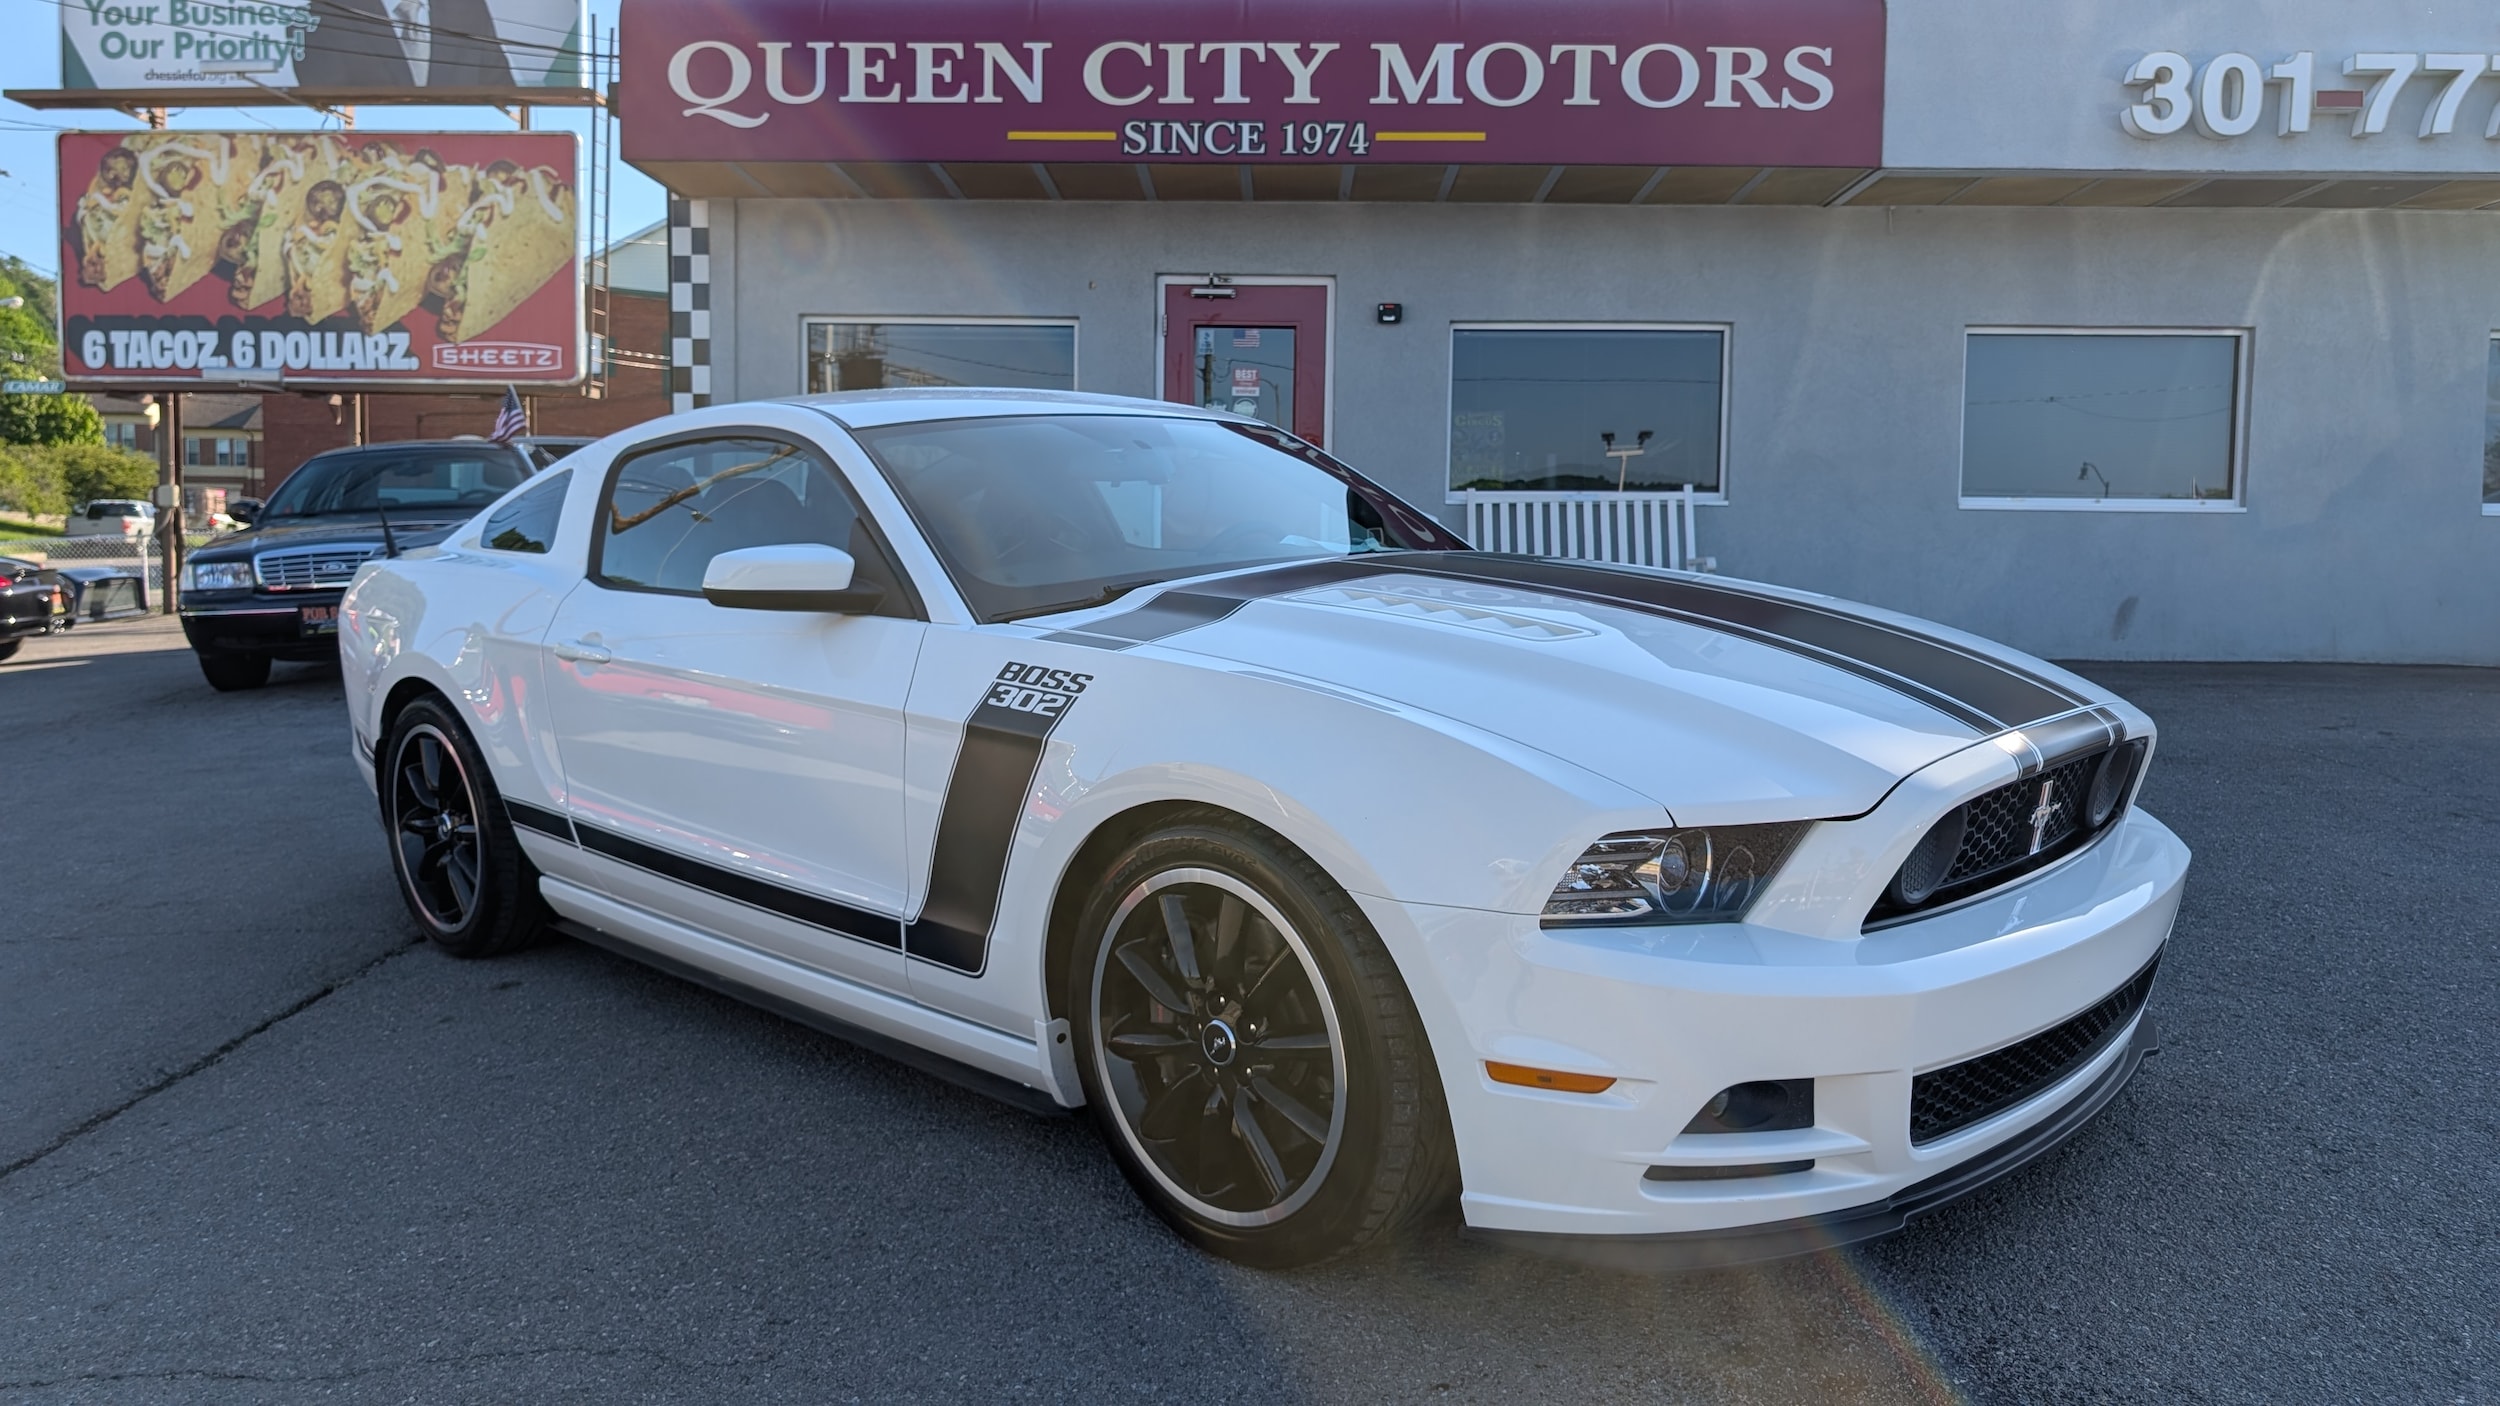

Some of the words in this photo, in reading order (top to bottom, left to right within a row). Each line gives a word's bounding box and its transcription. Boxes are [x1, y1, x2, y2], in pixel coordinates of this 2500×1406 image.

[84, 0, 159, 26] Your
[169, 0, 321, 32] Business,
[100, 31, 164, 60] Our
[174, 30, 306, 69] Priority!
[667, 41, 1053, 128] QUEEN
[1082, 41, 1340, 106] CITY
[1369, 42, 1835, 111] MOTORS
[1123, 121, 1266, 155] SINCE
[1281, 122, 1369, 155] 1974
[82, 330, 107, 369] 6
[109, 330, 228, 369] TACOZ.
[231, 330, 256, 369] 6
[260, 331, 420, 371] DOLLARZ.
[442, 349, 553, 366] SHEETZ
[8, 381, 60, 393] LAMAR
[995, 661, 1094, 694] BOSS
[987, 685, 1067, 717] 302
